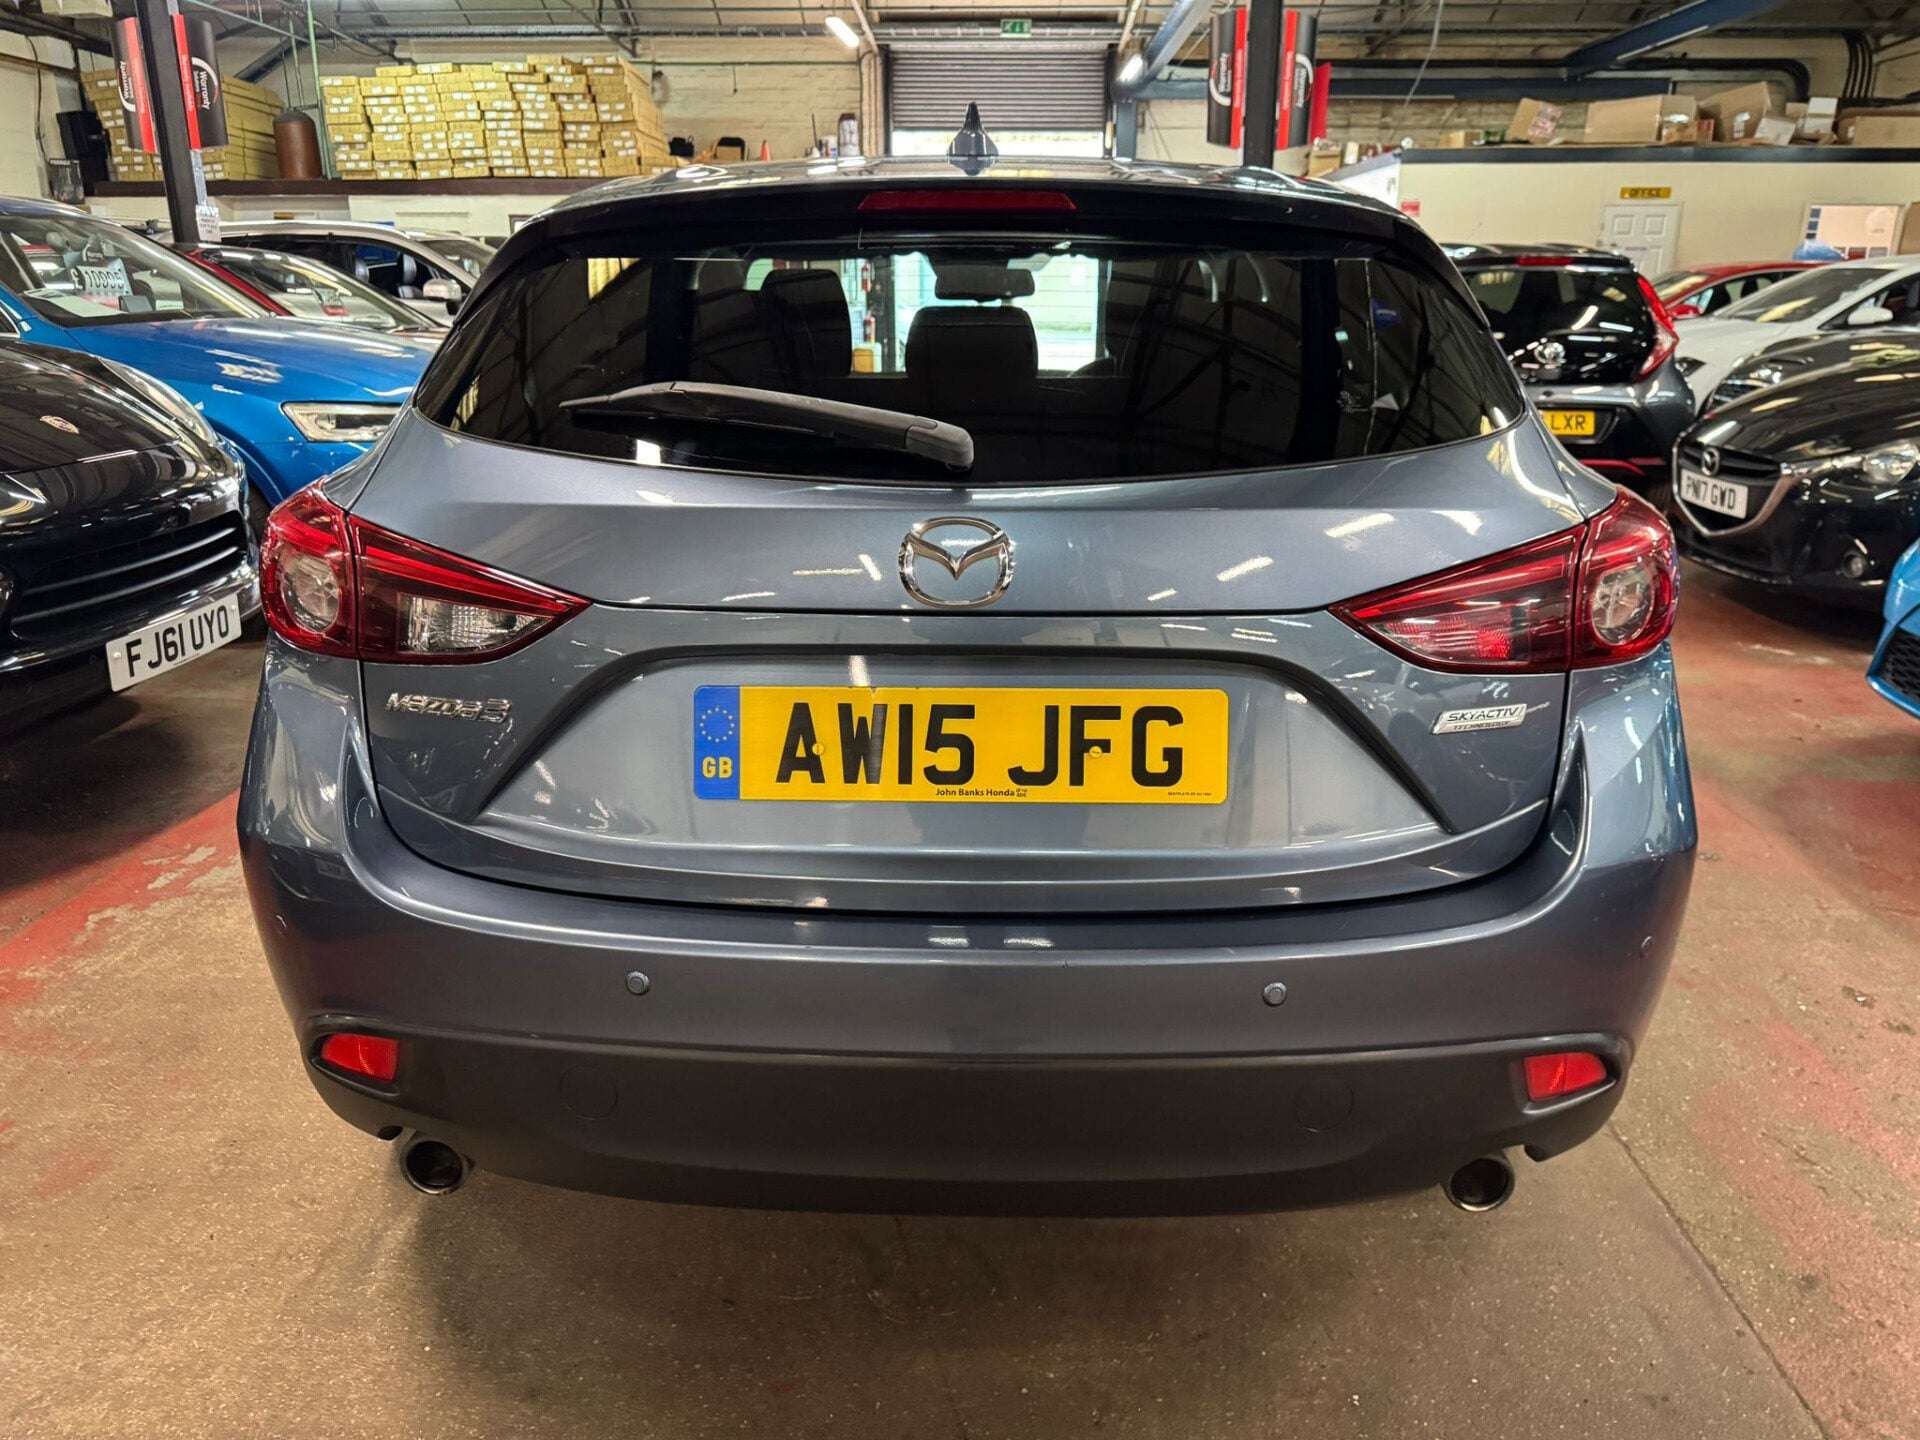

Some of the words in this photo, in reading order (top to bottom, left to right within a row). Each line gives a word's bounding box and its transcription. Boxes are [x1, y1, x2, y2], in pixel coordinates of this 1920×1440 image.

[120, 61, 129, 99] Warranty
[1218, 52, 1228, 93] Warranty
[1297, 68, 1307, 108] Warranty
[199, 71, 211, 110] Warranty
[1630, 187, 1661, 199] OFFICE
[1551, 414, 1586, 430] LXR
[1711, 483, 1736, 510] GWD
[126, 623, 185, 678] FJ61
[190, 605, 229, 651] UYO
[1447, 706, 1519, 722] SKYACTIV
[775, 702, 975, 786] AW15
[1007, 704, 1183, 787] JFG
[703, 756, 733, 778] GB
[936, 788, 957, 796] John
[959, 788, 984, 797] Banks
[986, 788, 1014, 797] Honda
